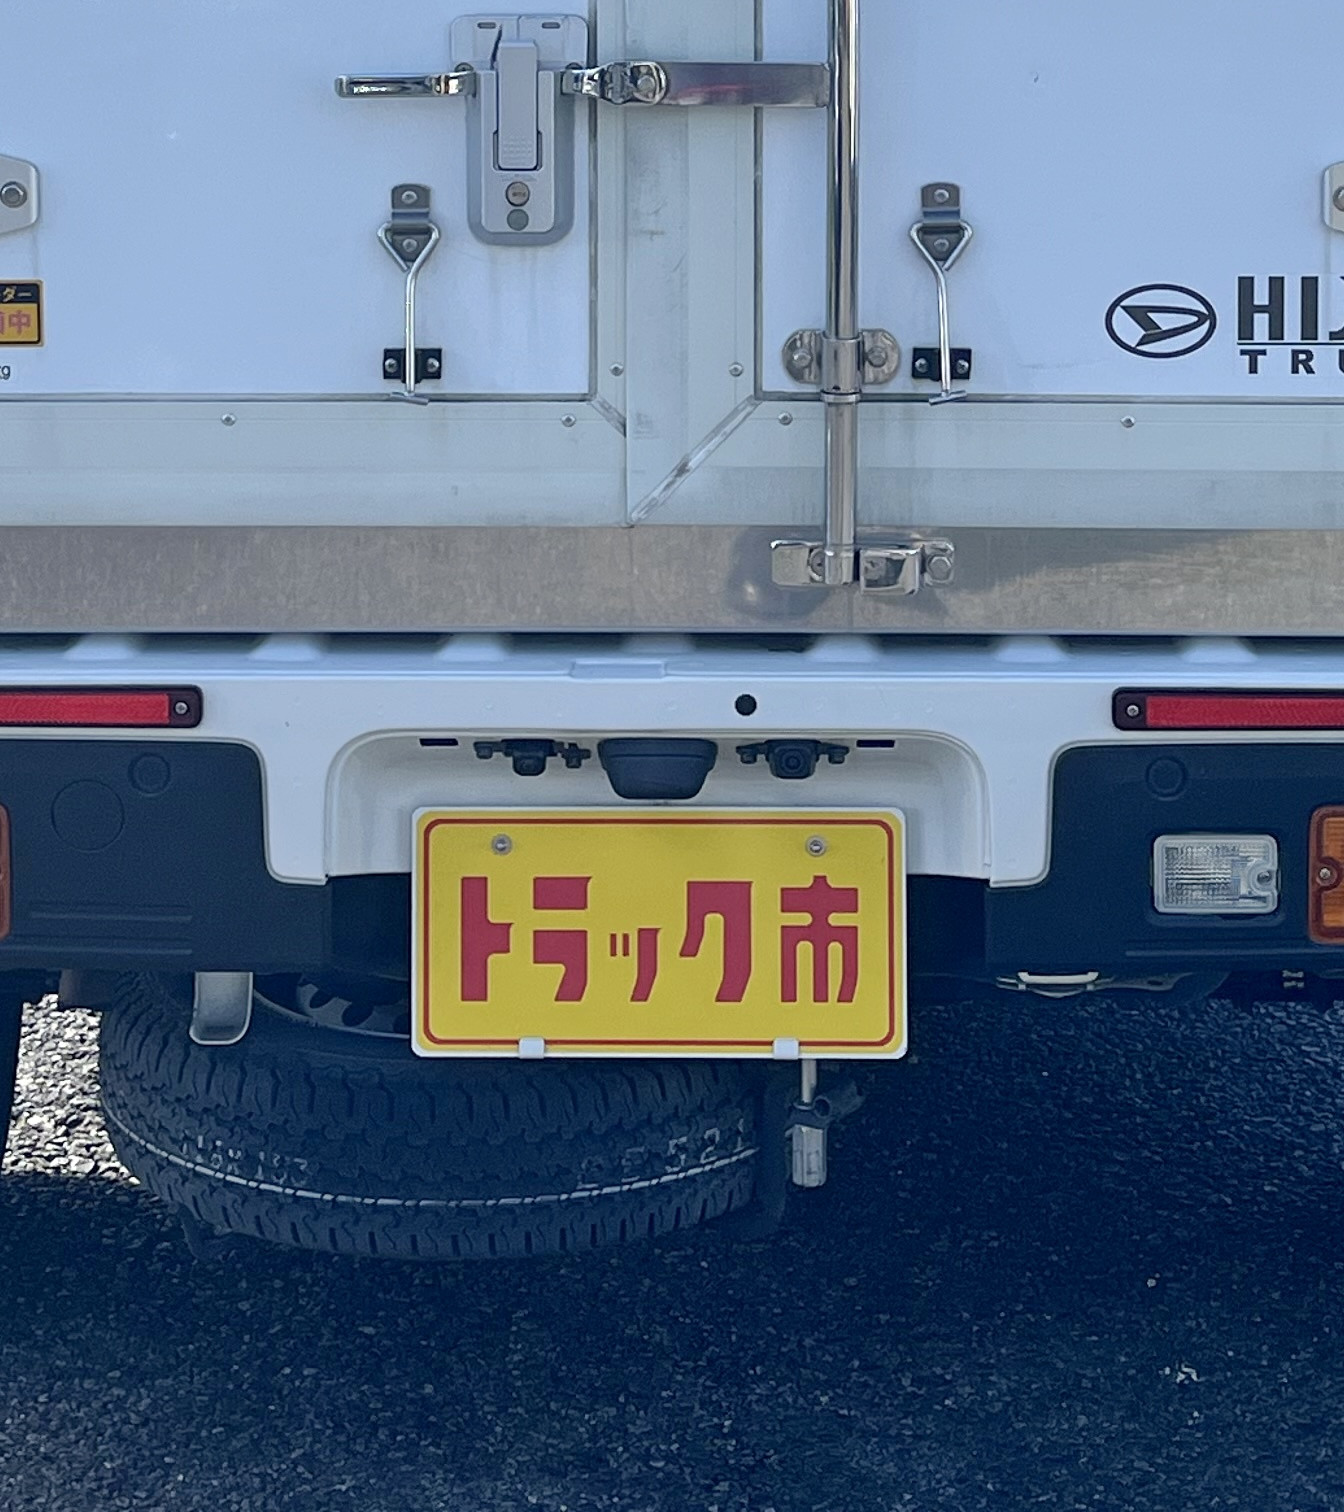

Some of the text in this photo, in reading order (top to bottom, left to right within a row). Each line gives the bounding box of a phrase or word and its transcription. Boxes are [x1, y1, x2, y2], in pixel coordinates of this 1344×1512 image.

[460, 875, 859, 1003] トラック市
